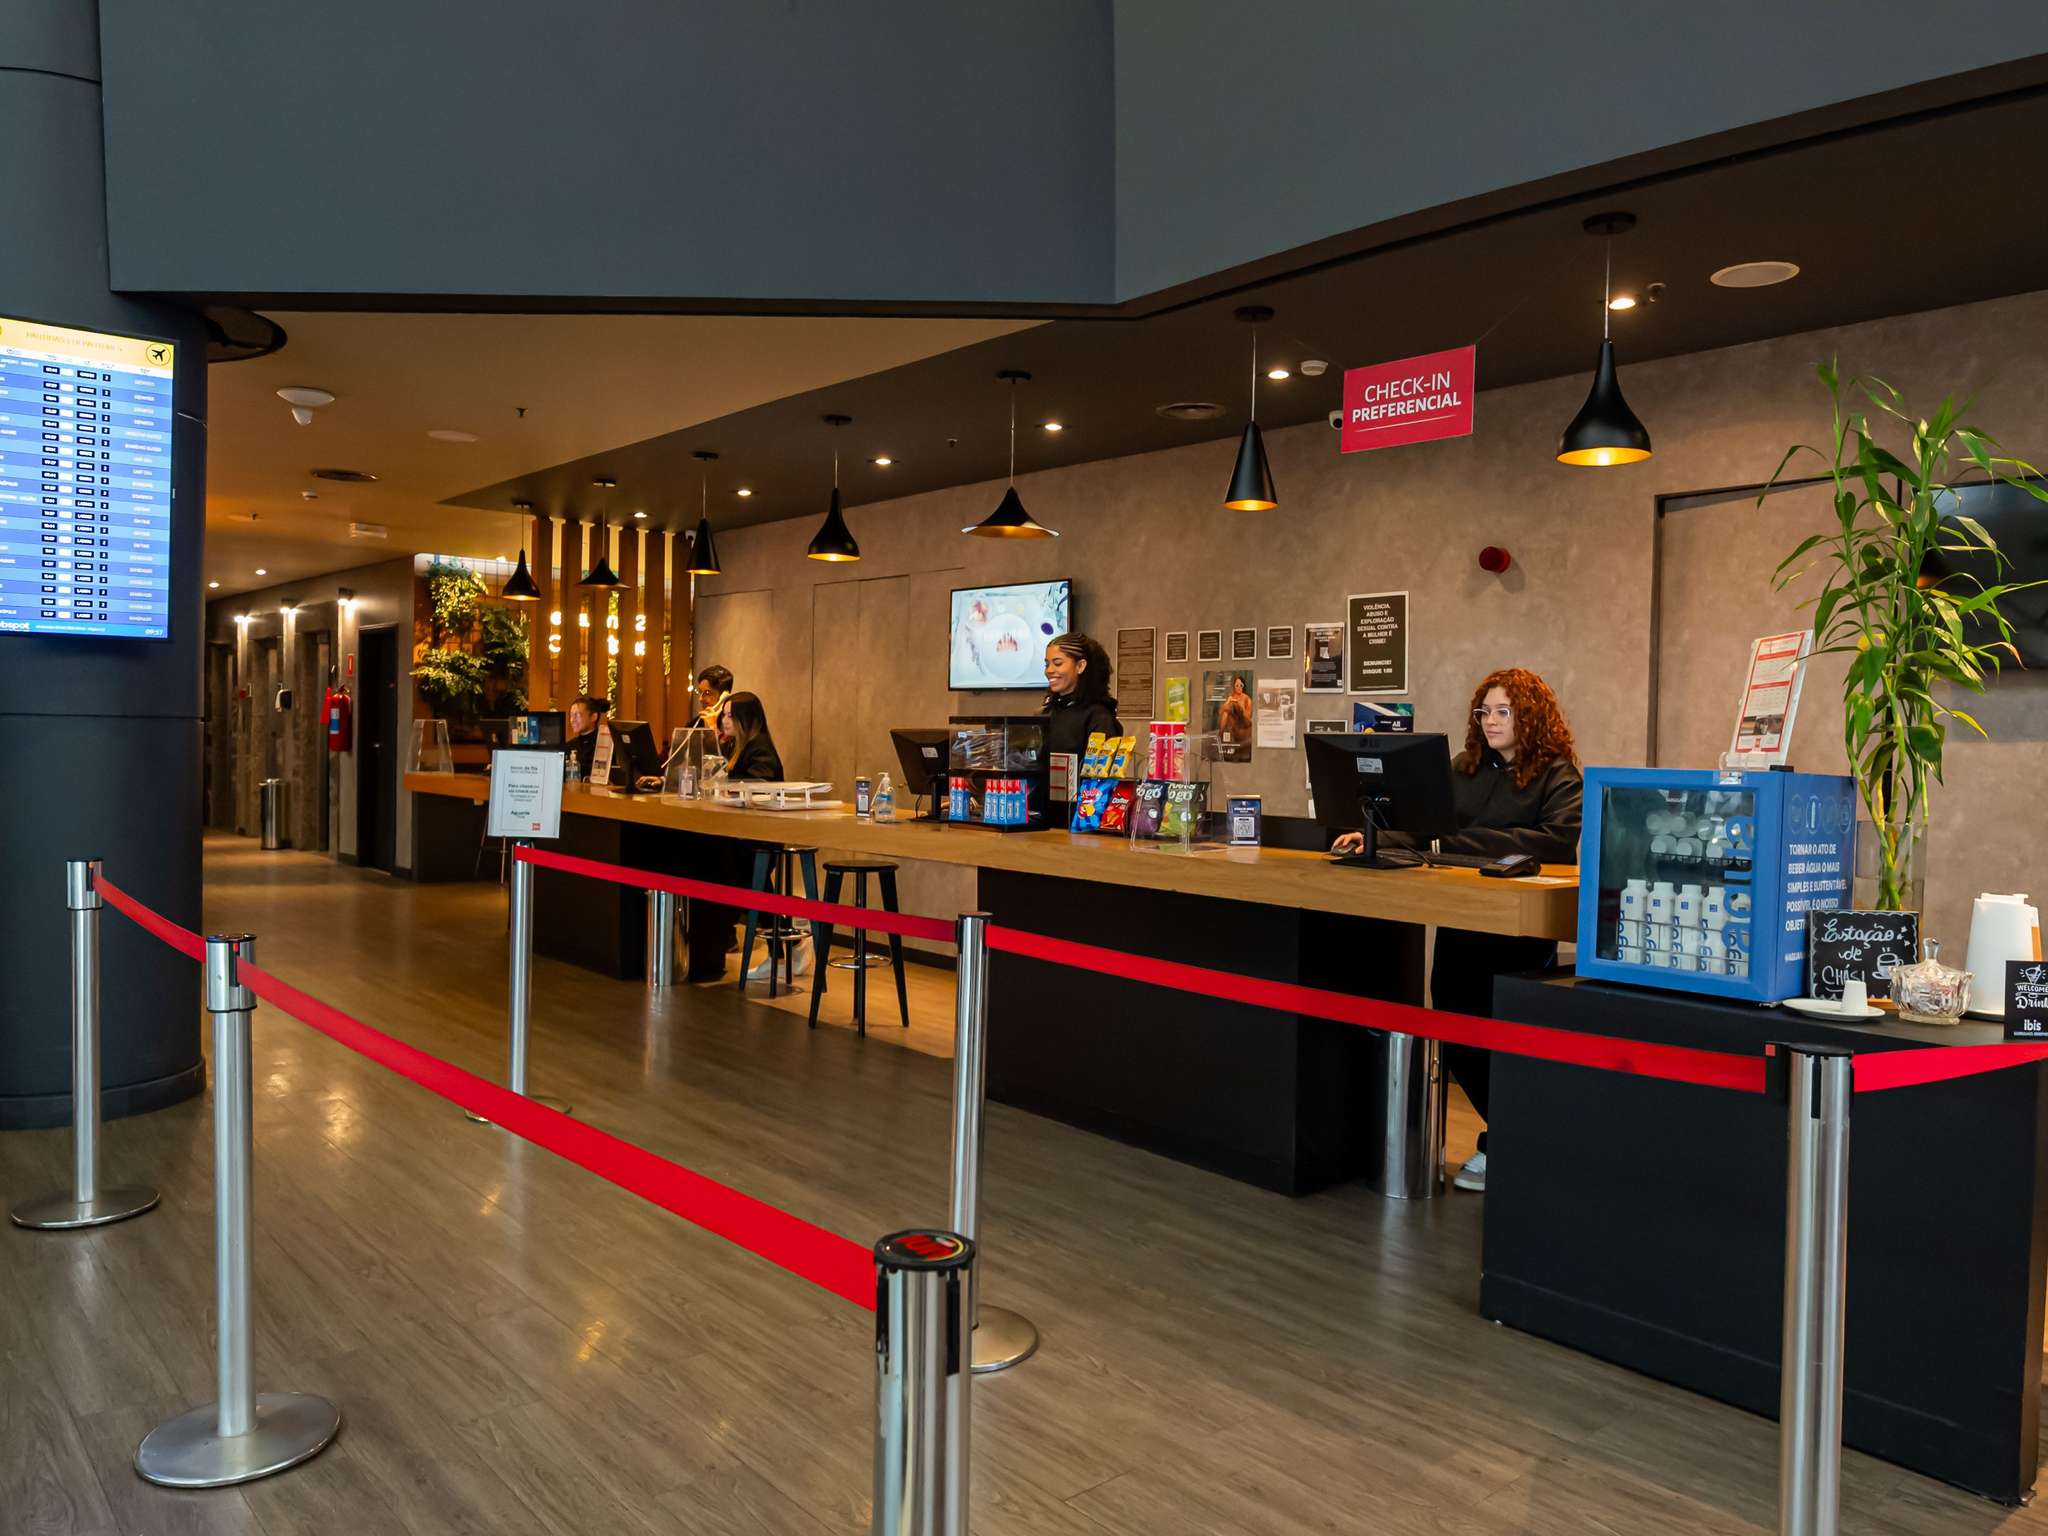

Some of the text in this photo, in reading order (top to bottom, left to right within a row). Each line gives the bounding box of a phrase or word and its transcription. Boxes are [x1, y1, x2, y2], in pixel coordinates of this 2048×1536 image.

[1364, 371, 1450, 403] CHECK-IN
[1352, 391, 1462, 423] PREFERENCIAL
[1377, 623, 1399, 631] CONTRA
[1789, 843, 1837, 856] TORNAR O ATO DE
[1788, 860, 1840, 874] BEBER ÁGUA O MAIS
[1787, 880, 1809, 893] SIMPLES
[1809, 880, 1814, 892] E
[1785, 918, 1806, 932] OBJETI
[1821, 918, 1895, 949] Estação
[1838, 945, 1863, 961] de
[2023, 1019, 2042, 1031] ibis
